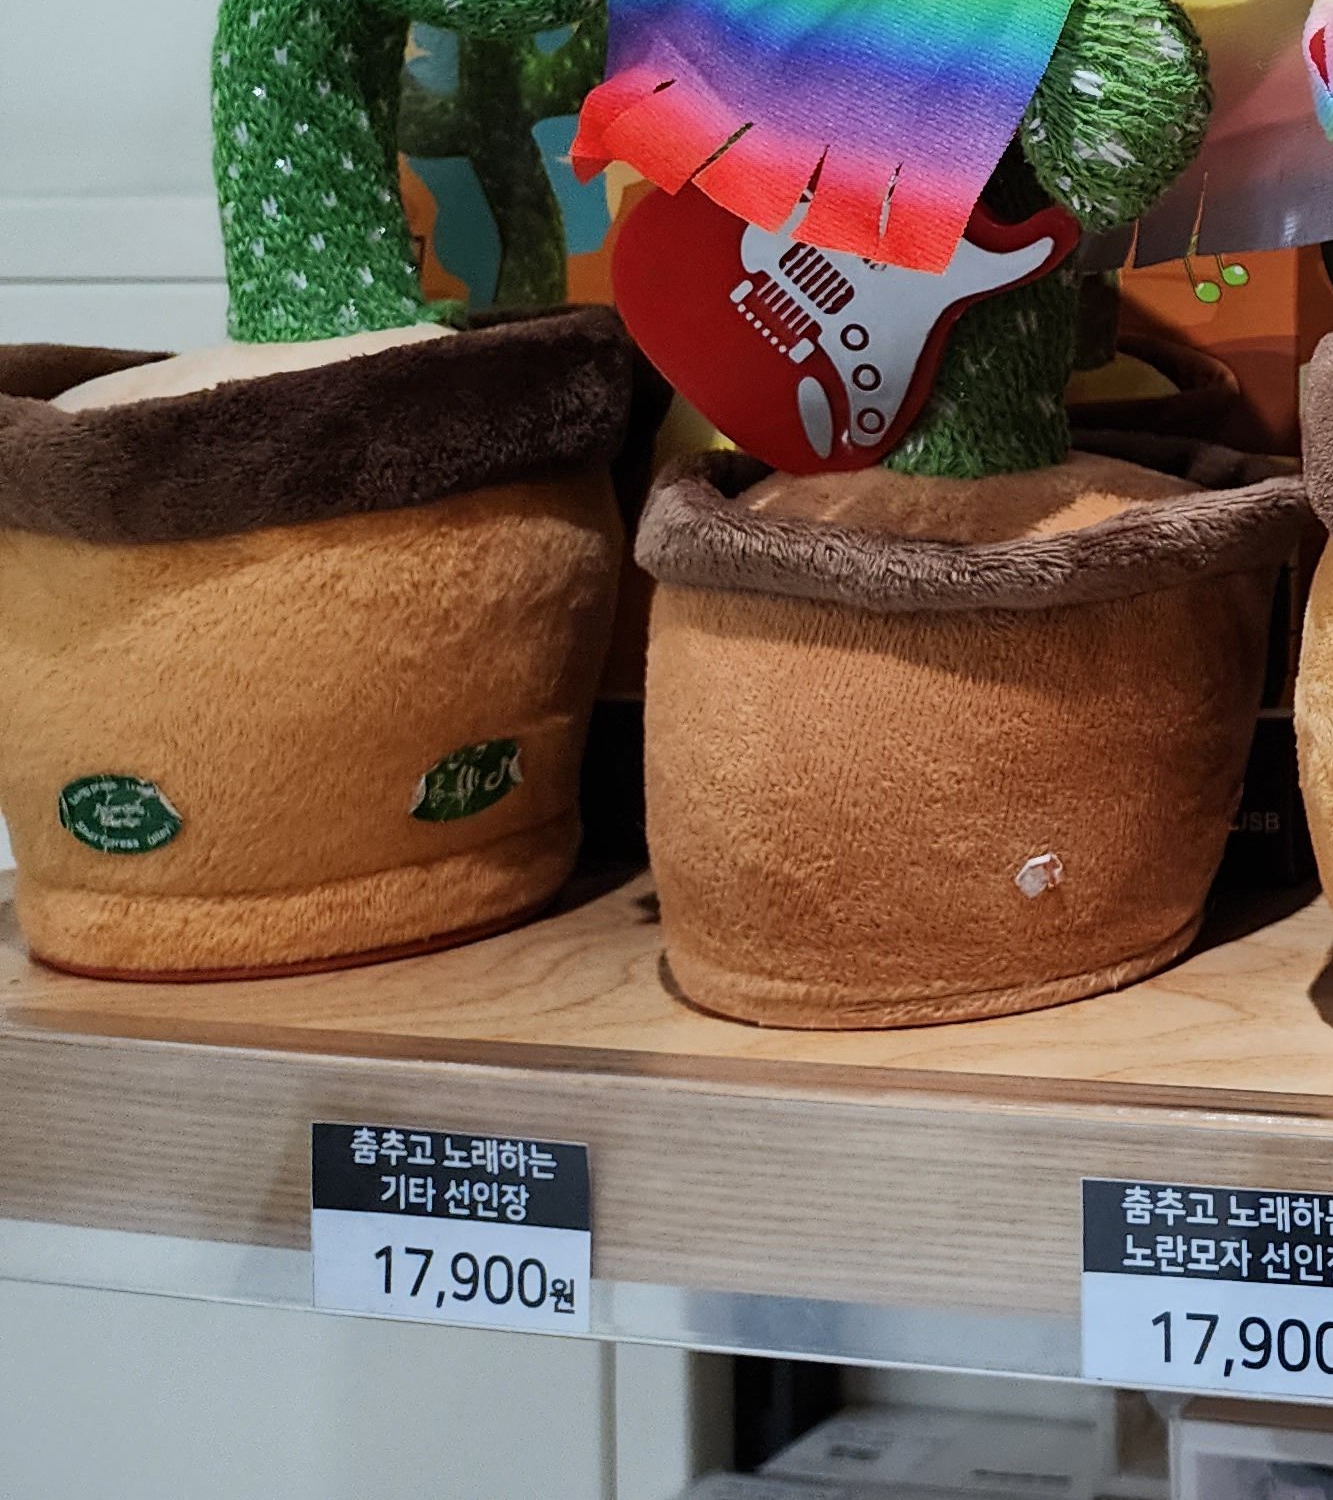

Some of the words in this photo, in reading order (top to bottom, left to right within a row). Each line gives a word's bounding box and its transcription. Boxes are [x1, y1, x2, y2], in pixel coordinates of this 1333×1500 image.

[350, 1127, 436, 1167] 춤추고
[442, 1135, 558, 1181] 노래하는
[380, 1174, 436, 1211] 기타
[444, 1179, 530, 1221] 선인장
[1121, 1185, 1219, 1227] 춤추고
[374, 1245, 576, 1314] 17,900원
[1122, 1234, 1253, 1278] 노란모자
